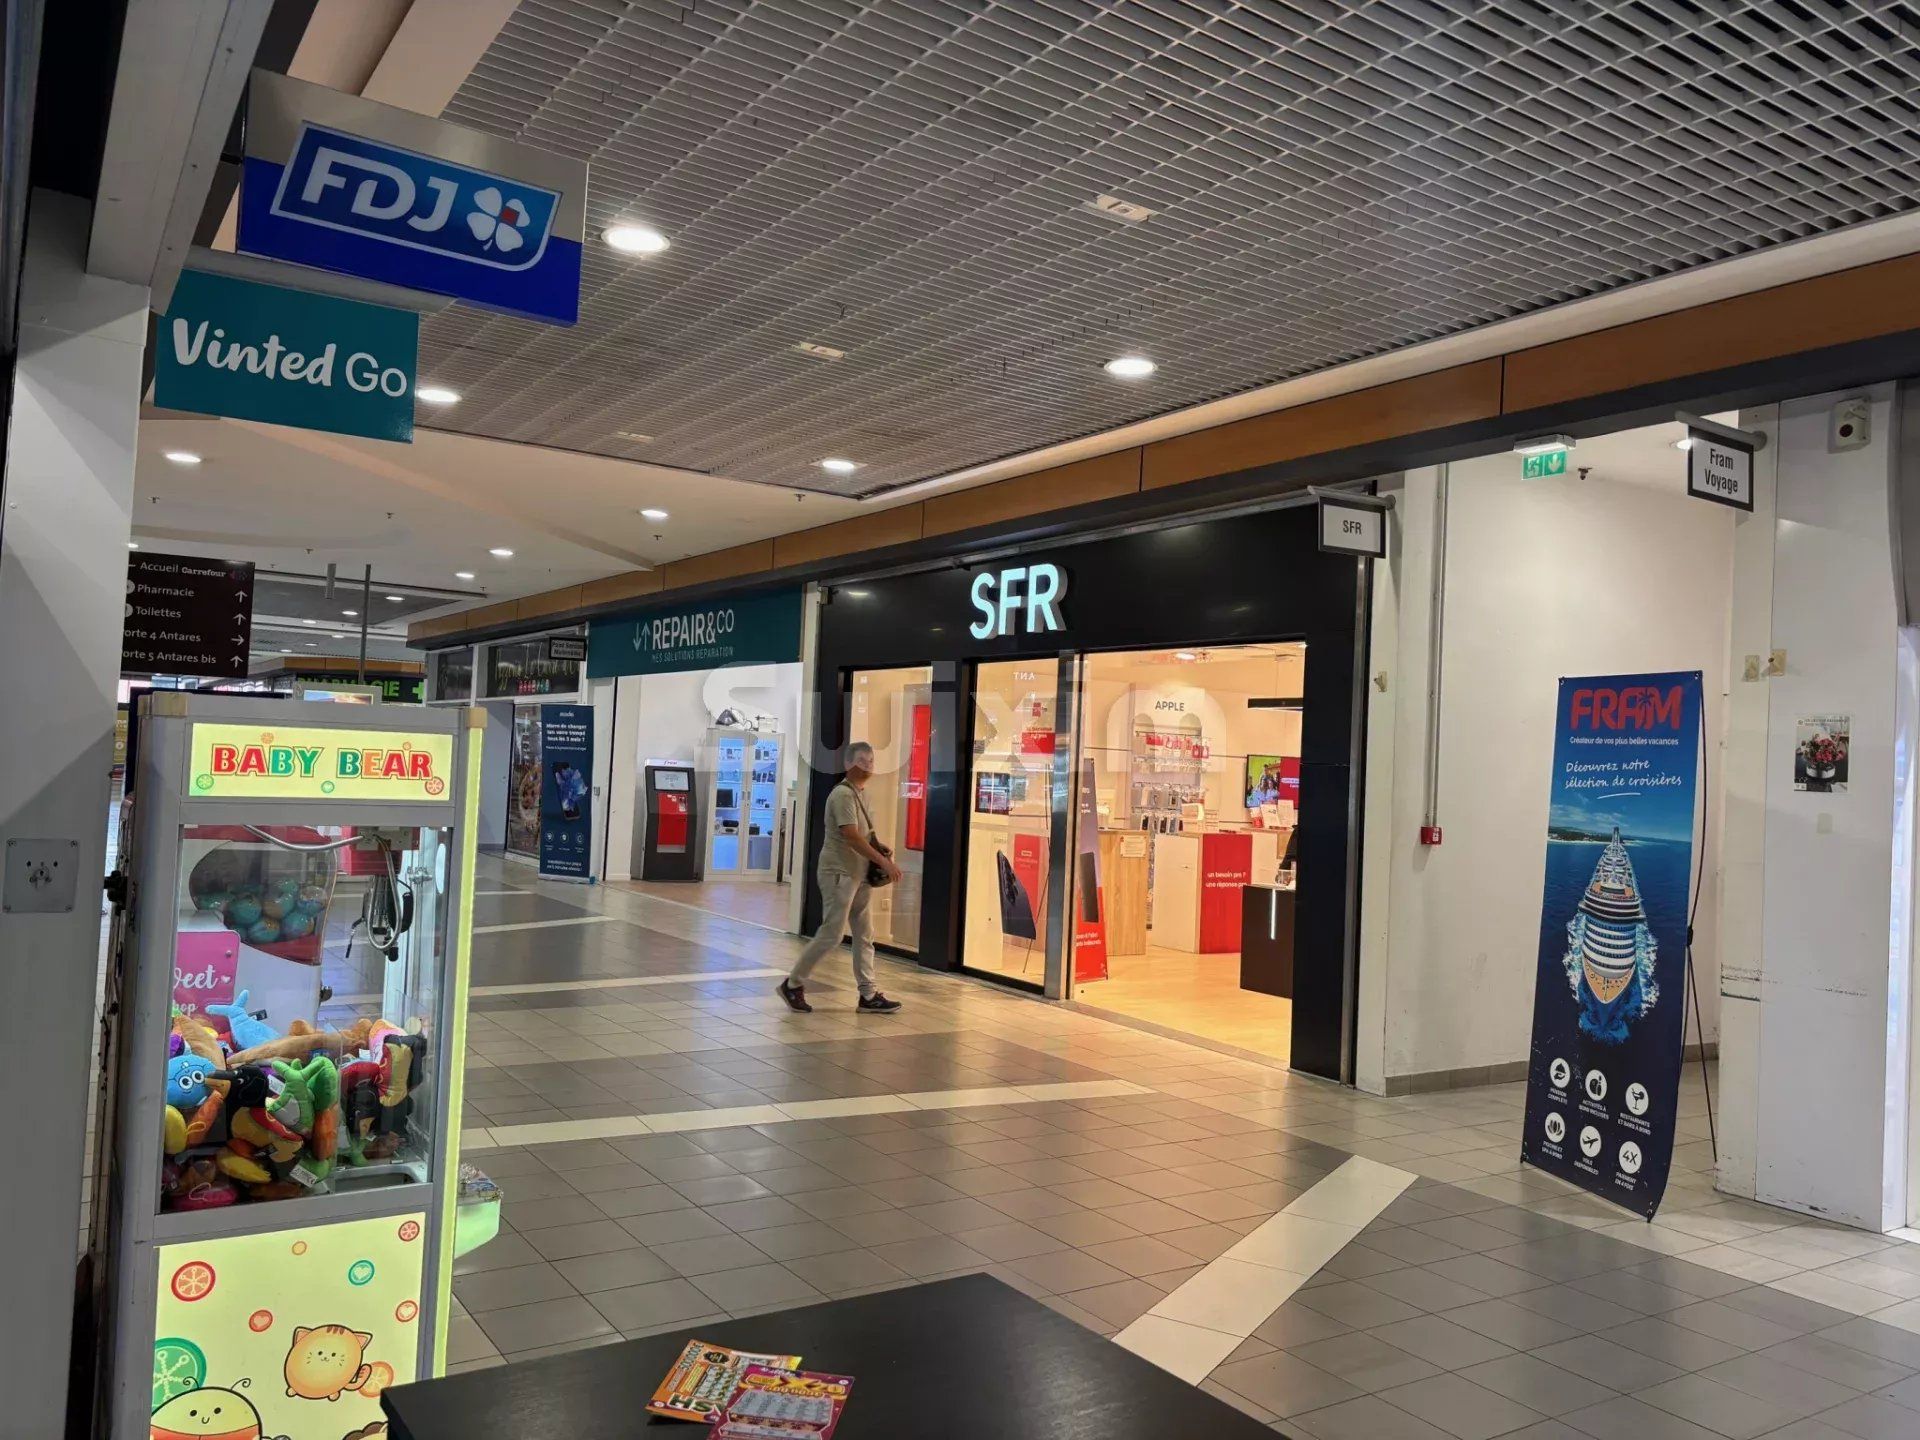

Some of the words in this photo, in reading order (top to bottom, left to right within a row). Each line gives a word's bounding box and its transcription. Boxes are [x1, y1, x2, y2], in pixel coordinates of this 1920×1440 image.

[301, 145, 459, 233] FDJ
[172, 318, 336, 388] Vinted
[345, 351, 408, 398] Go
[1709, 448, 1734, 471] Fram
[1704, 468, 1739, 494] Voyage
[1342, 519, 1363, 536] SFR
[140, 561, 179, 573] Accueil
[181, 567, 227, 578] Carrefour
[137, 584, 195, 597] Pharmacie
[969, 563, 1063, 639] SFR
[136, 605, 182, 618] Toilettes
[124, 629, 147, 639] orte
[149, 631, 157, 641] 4
[159, 630, 201, 642] Antares
[652, 608, 735, 650] REPAIR&CO
[122, 650, 146, 659] orte
[148, 651, 154, 662] 5
[156, 651, 199, 663] Antares
[200, 654, 217, 664] bis
[1154, 700, 1185, 712] APPLE
[1569, 686, 1683, 731] FRAM
[1595, 736, 1603, 745] de
[1604, 737, 1614, 745] vos
[1614, 736, 1628, 746] plus
[1629, 737, 1648, 745] belles
[1648, 738, 1679, 746] vacances
[211, 744, 324, 778] BABY
[336, 748, 433, 781] BEAR
[1566, 760, 1618, 773] Découvrez
[1622, 758, 1650, 771] notre
[1564, 776, 1609, 789] sélection
[1612, 774, 1625, 786] de
[1628, 771, 1682, 787] croisières
[1622, 1150, 1638, 1166] 4X
